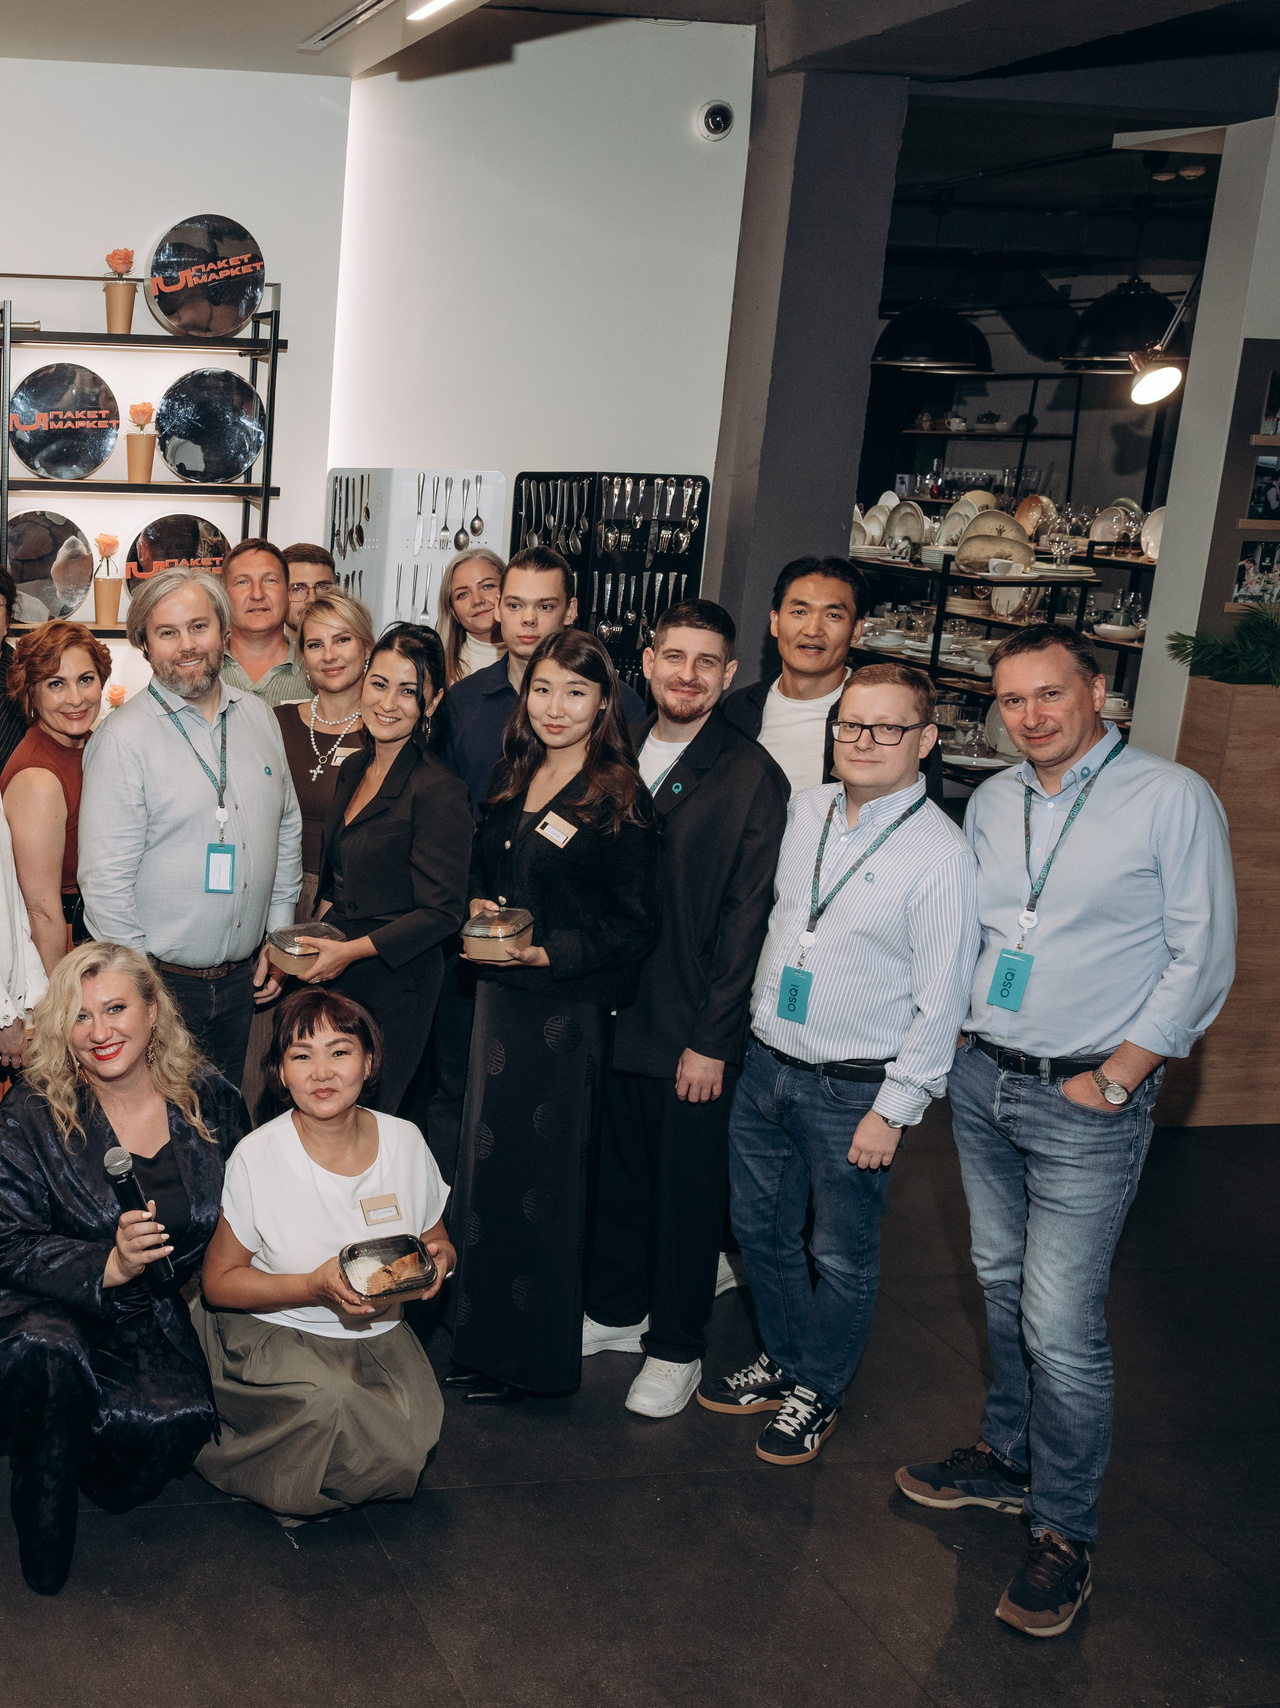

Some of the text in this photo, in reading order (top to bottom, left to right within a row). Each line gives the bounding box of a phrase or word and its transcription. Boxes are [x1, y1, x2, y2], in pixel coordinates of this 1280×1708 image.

[192, 253, 251, 274] ПАКЕТ
[193, 261, 264, 285] МАРКЕТ
[50, 410, 110, 419] ПАКЕТ
[50, 420, 120, 430] МАРКЕТ
[165, 557, 224, 567] ПАКЕТ
[1070, 793, 1086, 818] GROUP
[866, 835, 885, 856] GROUP
[824, 883, 841, 904] GROUP
[1033, 880, 1044, 895] OSQ
[1000, 972, 1015, 998] OSQ
[788, 988, 798, 1012] OSQ
